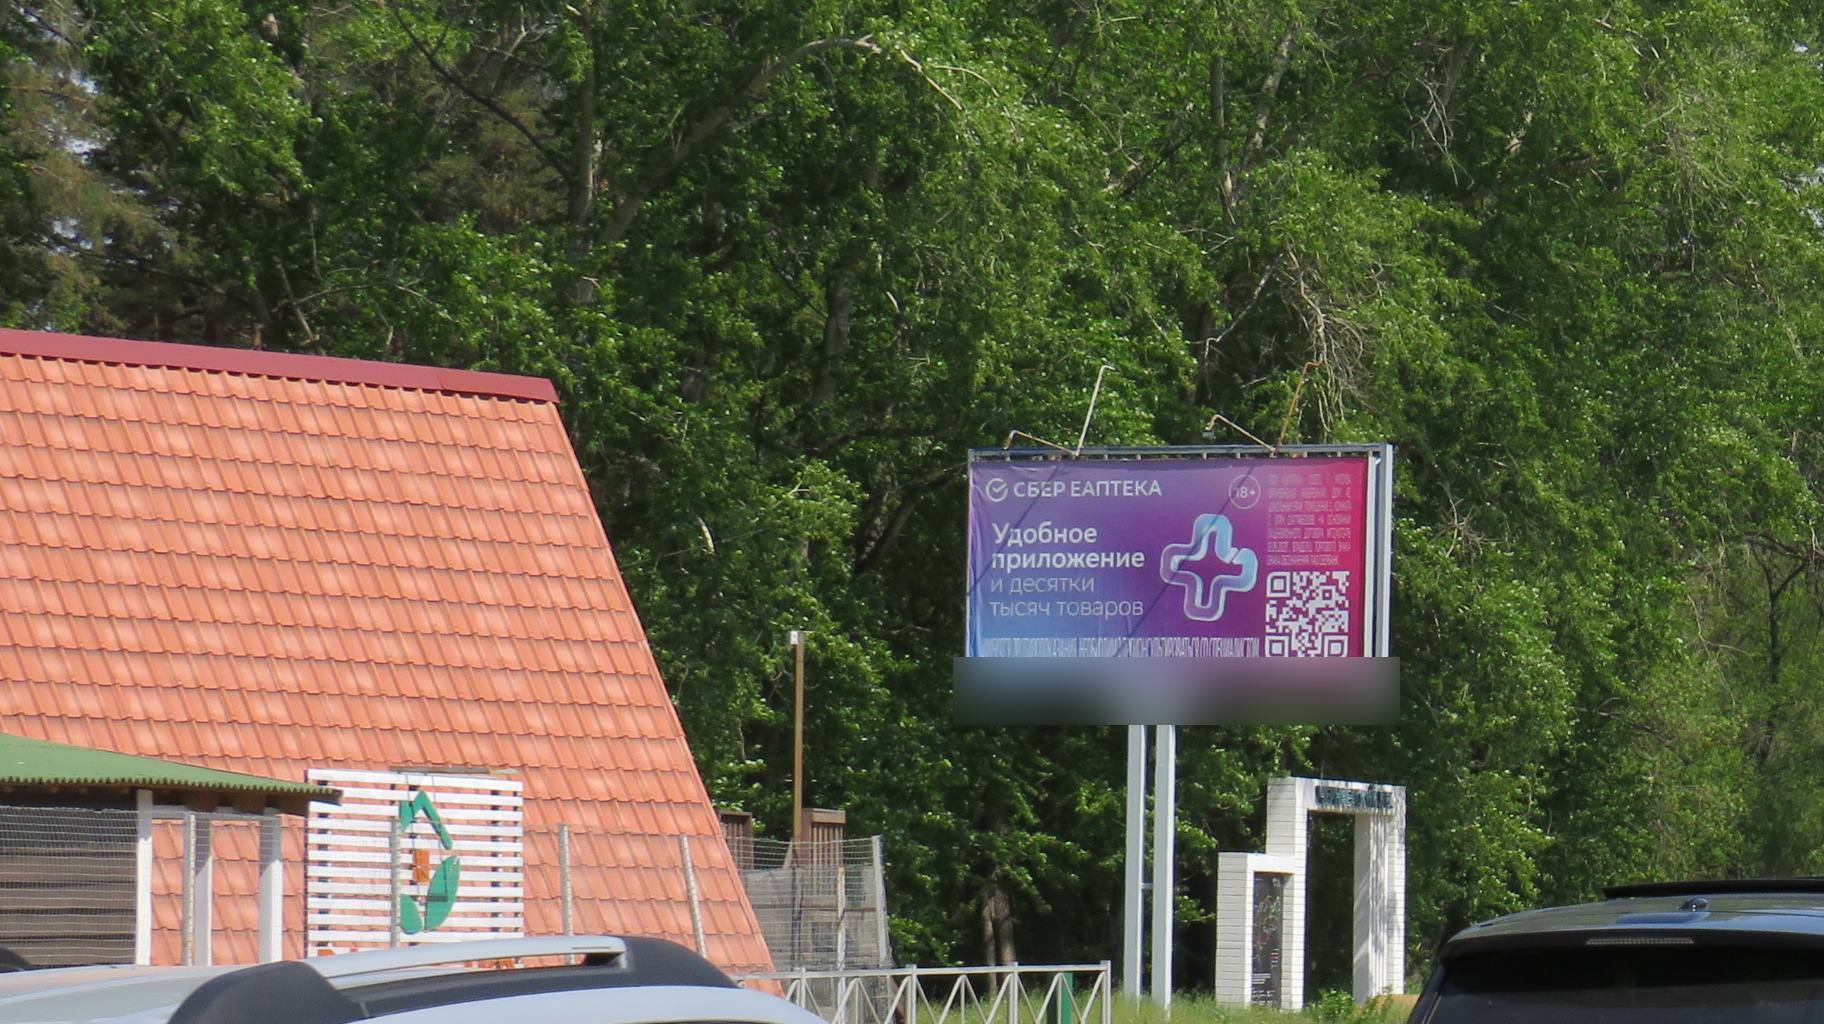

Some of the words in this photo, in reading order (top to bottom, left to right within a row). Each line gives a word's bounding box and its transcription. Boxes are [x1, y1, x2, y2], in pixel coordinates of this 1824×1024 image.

[1013, 481, 1066, 498] СБЕР
[1070, 479, 1162, 497] ЕАПТЕКА
[1235, 486, 1256, 499] 18+
[991, 520, 1098, 547] Удобное
[991, 551, 1146, 574] приложение
[990, 578, 1003, 593] и
[1008, 577, 1095, 596] десятки
[989, 601, 1050, 617] тысяч
[1056, 601, 1144, 620] товаров
